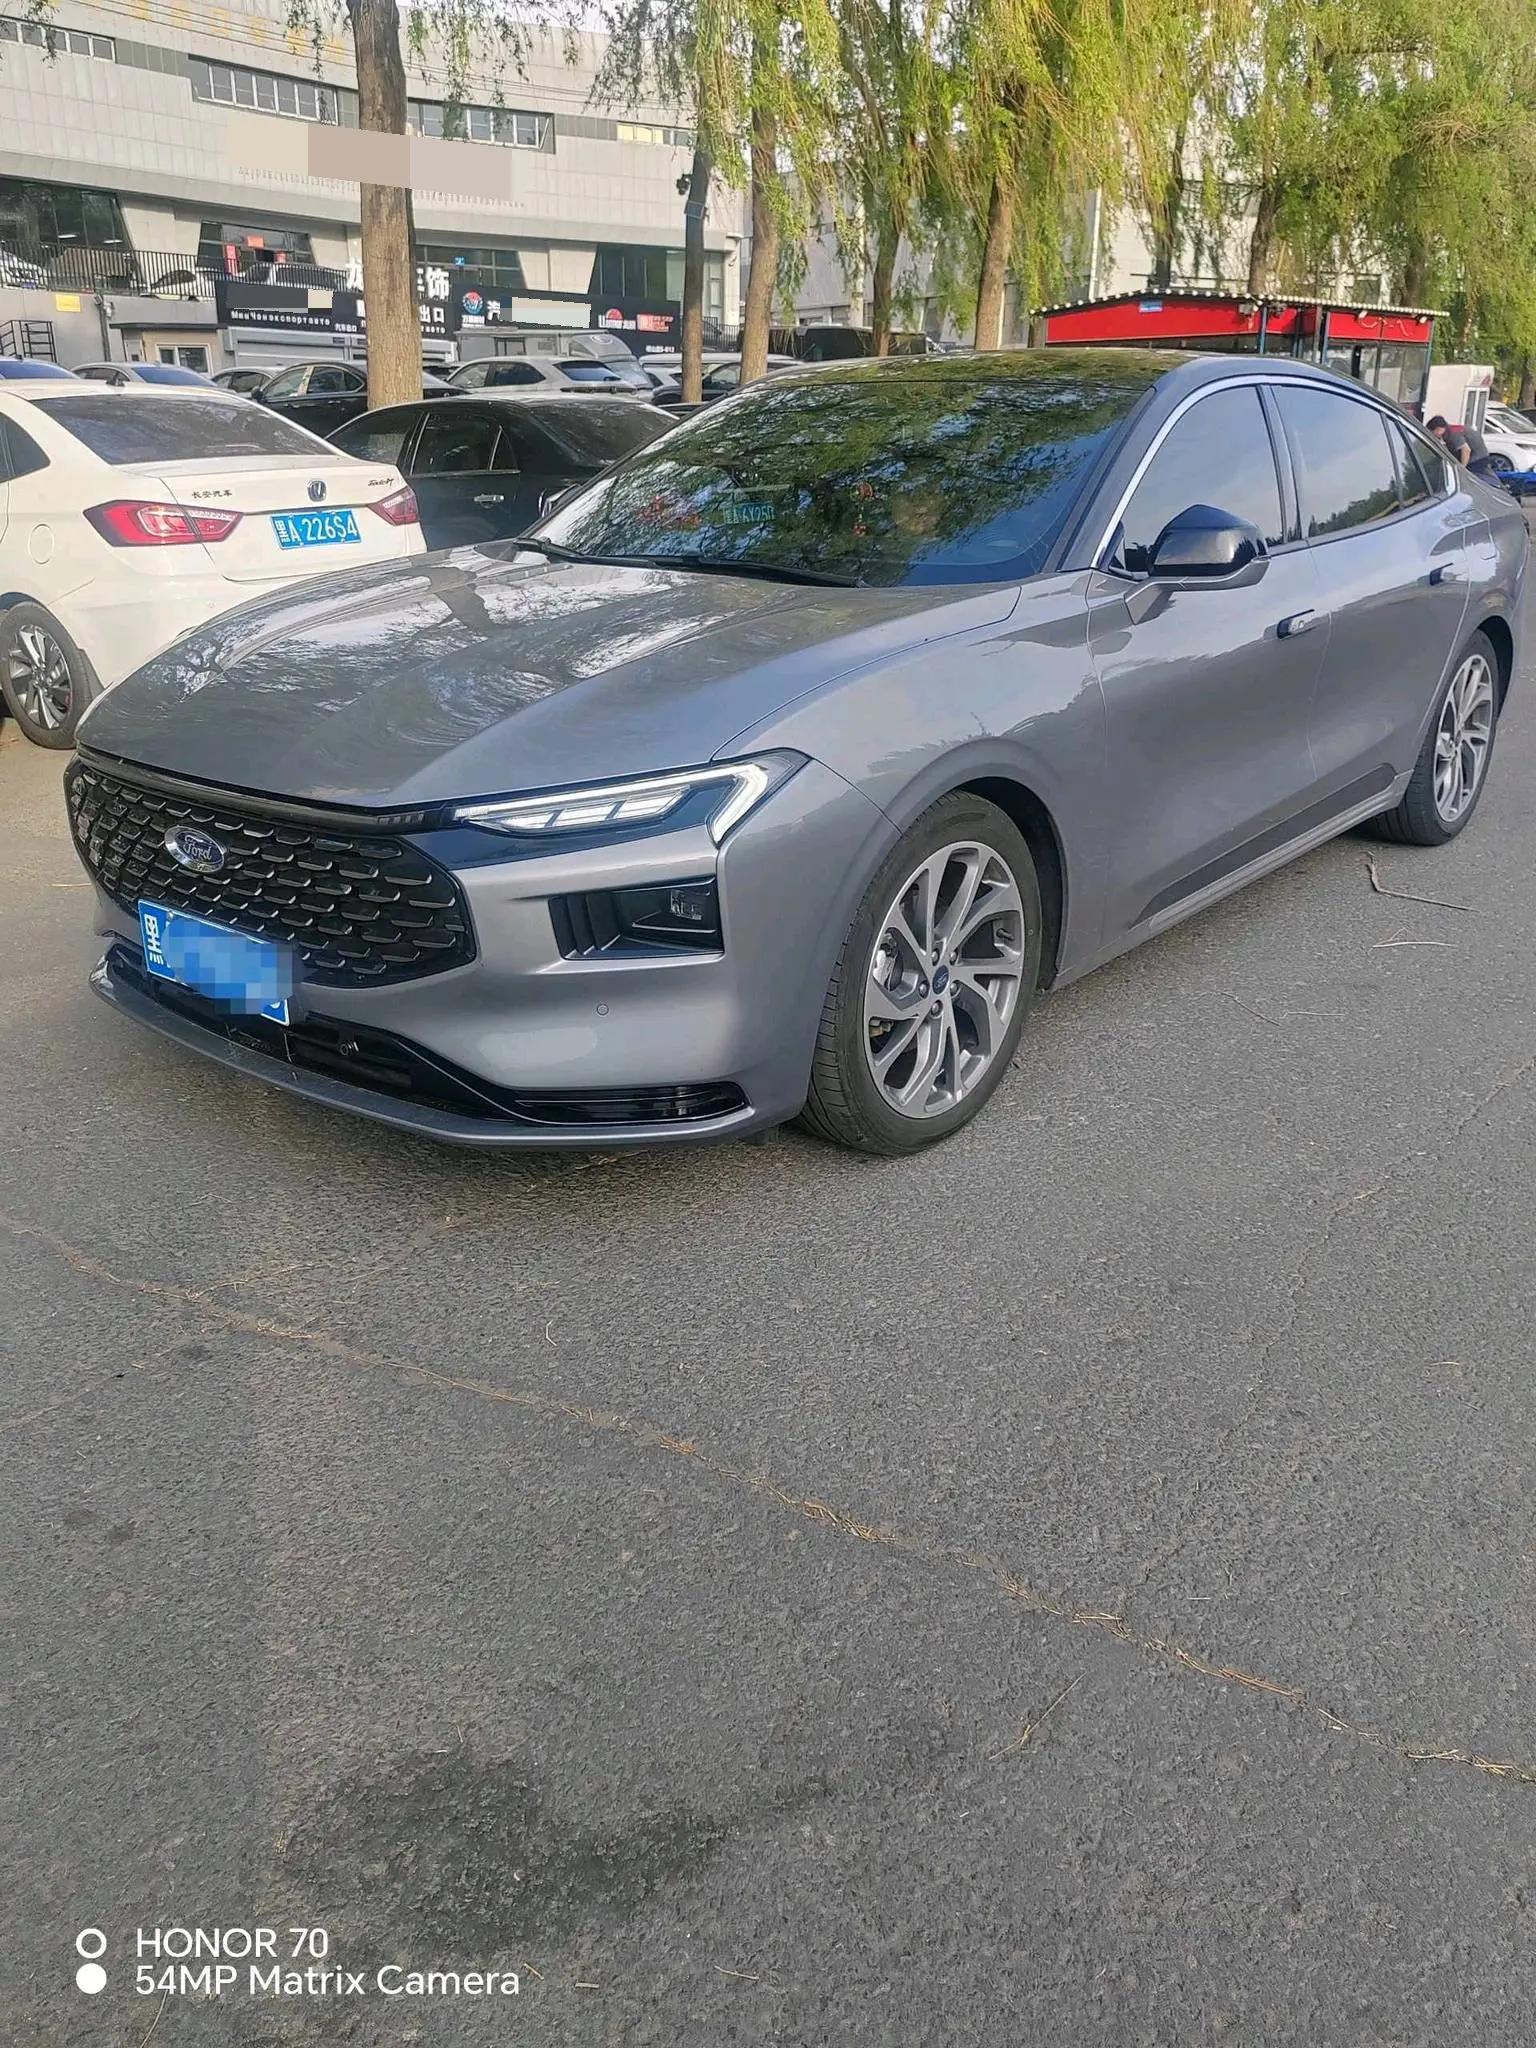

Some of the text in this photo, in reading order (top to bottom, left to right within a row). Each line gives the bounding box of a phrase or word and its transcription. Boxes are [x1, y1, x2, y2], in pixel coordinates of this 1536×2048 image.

[192, 489, 232, 499] 长安汽车
[182, 834, 213, 862] Ford
